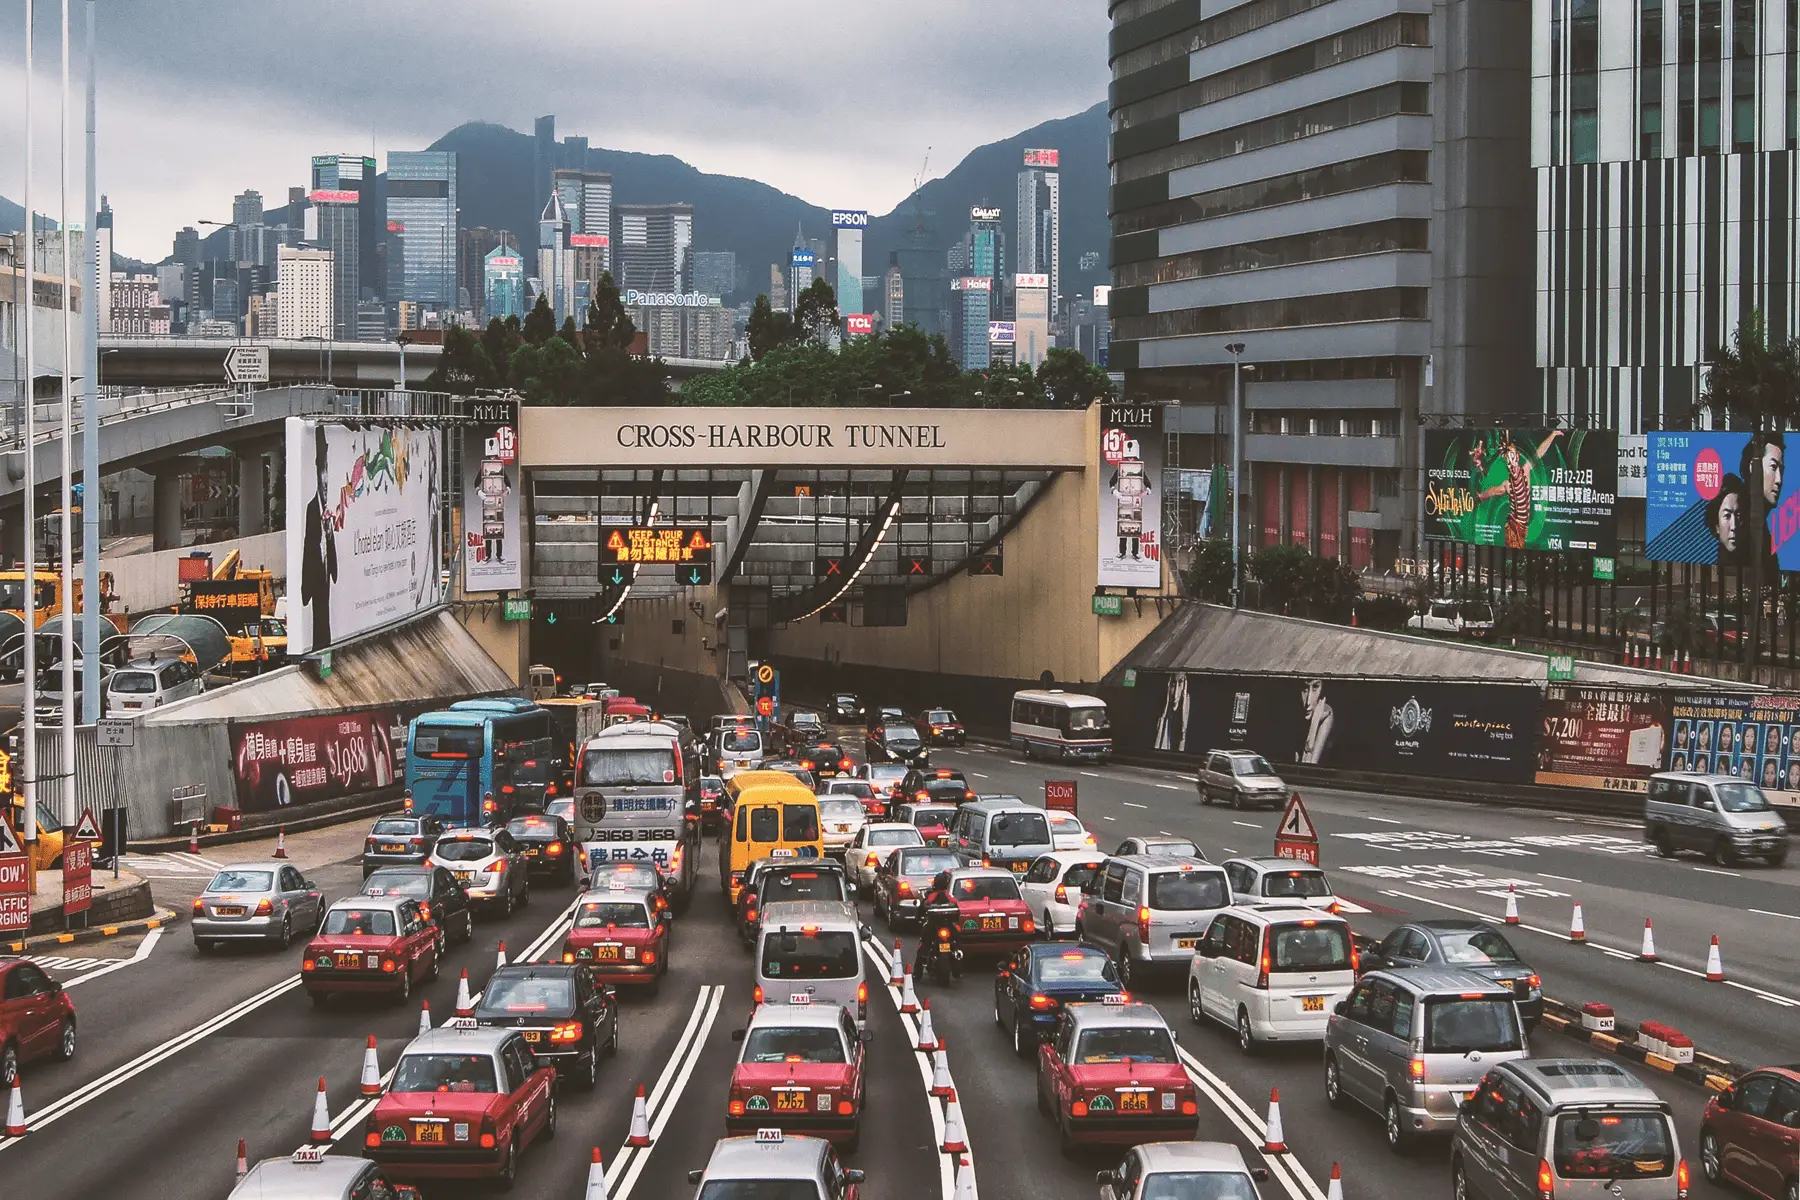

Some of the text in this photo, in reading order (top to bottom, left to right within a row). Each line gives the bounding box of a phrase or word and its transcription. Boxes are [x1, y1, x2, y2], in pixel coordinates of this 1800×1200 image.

[972, 207, 1000, 217] GALAXY
[832, 213, 867, 225] EPSON
[966, 279, 991, 289] Haier
[627, 289, 708, 307] Panasonic
[848, 318, 871, 328] TCL
[473, 405, 509, 419] MM/H
[1110, 409, 1152, 423] MM/H
[845, 425, 946, 448] TUNNEL
[1428, 469, 1471, 480] CIRQUE DU SOLEIL
[1551, 468, 1593, 485] 7月12-22日
[468, 531, 484, 547] SALE
[628, 530, 683, 540] KEEP YOUR
[1139, 530, 1155, 543] SALE
[631, 539, 680, 547] DISTANCE
[1548, 538, 1563, 549] VISA
[1145, 544, 1160, 562] ON
[1595, 558, 1613, 572] POAD
[194, 592, 259, 609] 保持行車距離
[507, 601, 529, 614] POAD
[1551, 657, 1572, 672] POAD
[1454, 719, 1511, 732] masterpiece
[1544, 717, 1584, 740] $7,200
[327, 736, 366, 787] $1,988
[1047, 785, 1073, 798] SLOW!
[596, 829, 676, 841] 3168 3168
[1123, 1101, 1146, 1109] 8646
[423, 1123, 436, 1132] JV
[421, 1132, 439, 1141] 6811
[759, 1131, 780, 1139] TAXI
[297, 1152, 318, 1160] TAXI
